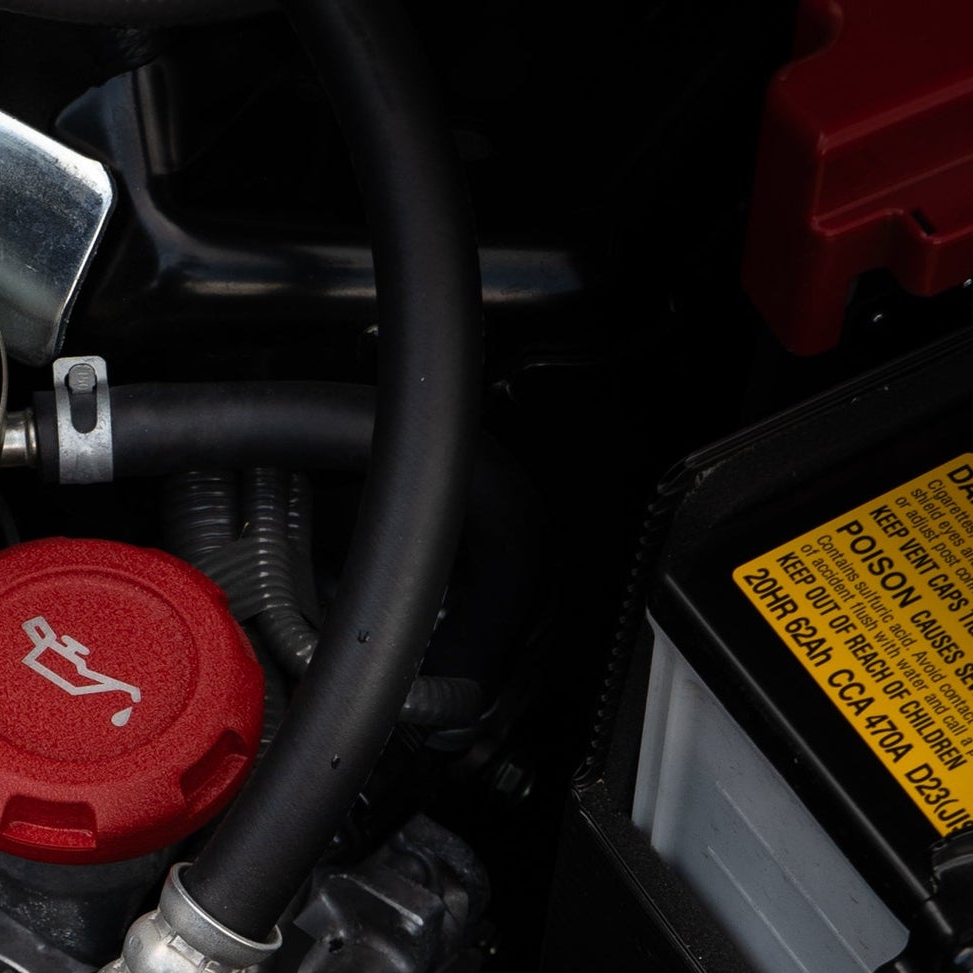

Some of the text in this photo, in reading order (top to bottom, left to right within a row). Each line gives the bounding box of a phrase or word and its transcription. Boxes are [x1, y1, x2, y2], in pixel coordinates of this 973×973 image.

[869, 505, 909, 540] KEEP
[899, 538, 940, 575] VENT
[928, 573, 969, 612] CAPS
[895, 496, 911, 508] or
[906, 510, 940, 542] adjust
[931, 543, 960, 566] post
[911, 488, 946, 520] shield
[938, 521, 965, 546] eyes
[776, 551, 967, 771] KEEP OUT OF REACH OF CHILDREN
[800, 544, 973, 746] of accident flush with water and call a
[817, 535, 860, 582] Contains
[854, 580, 895, 623] sulfuric
[889, 622, 917, 651] acid.
[912, 652, 946, 682] Avoid
[836, 519, 922, 608] POISON
[911, 610, 965, 664] CAUSES
[743, 567, 799, 620] 20HR
[784, 616, 833, 668] 62Ah
[827, 668, 875, 716] CCA
[865, 713, 914, 763] 470A
